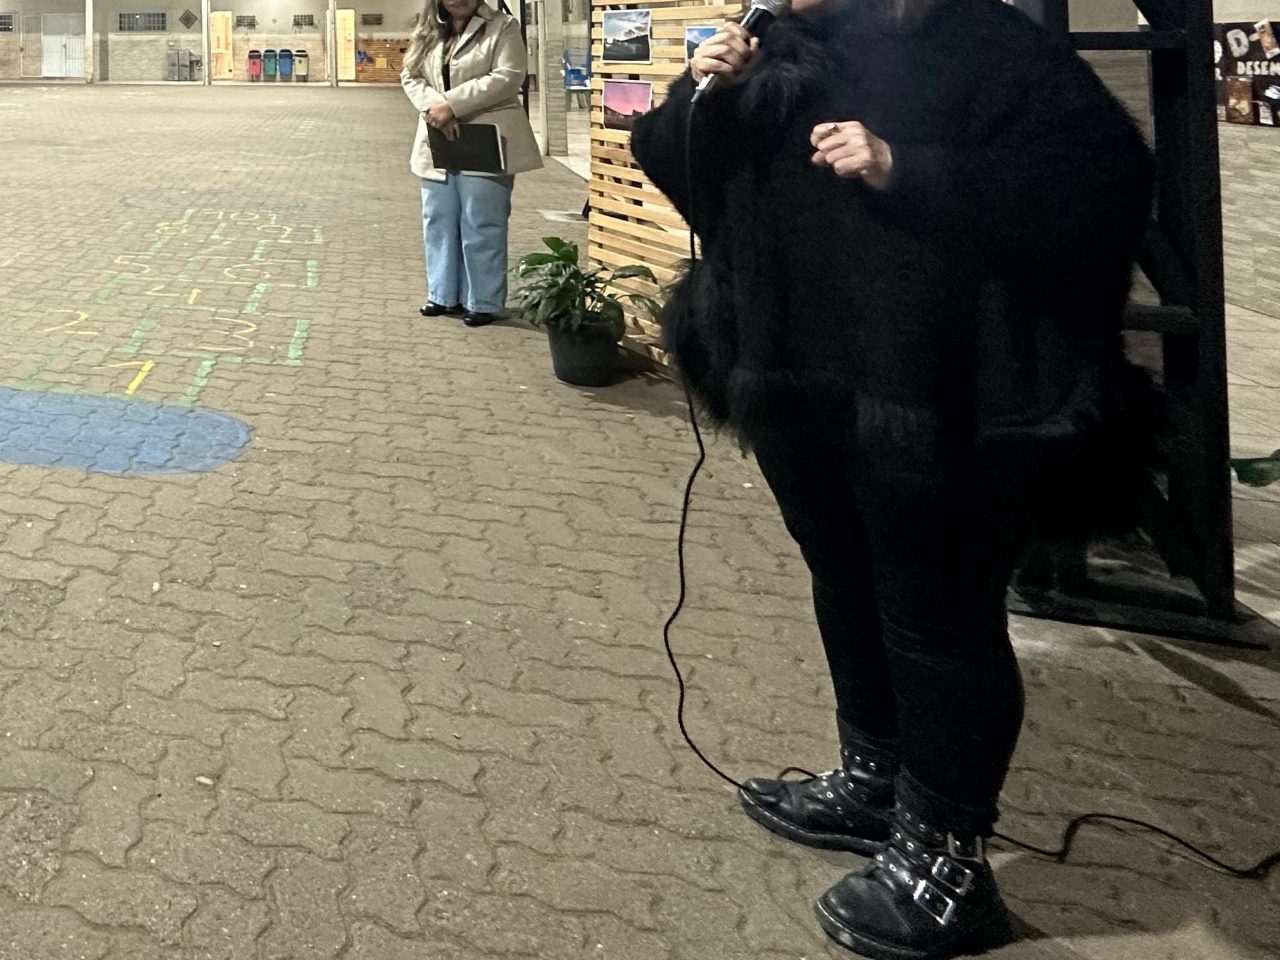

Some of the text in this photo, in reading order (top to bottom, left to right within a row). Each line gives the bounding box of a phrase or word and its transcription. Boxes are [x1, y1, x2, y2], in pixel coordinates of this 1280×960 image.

[35, 308, 258, 352] 2 3
[91, 359, 156, 395] 1
